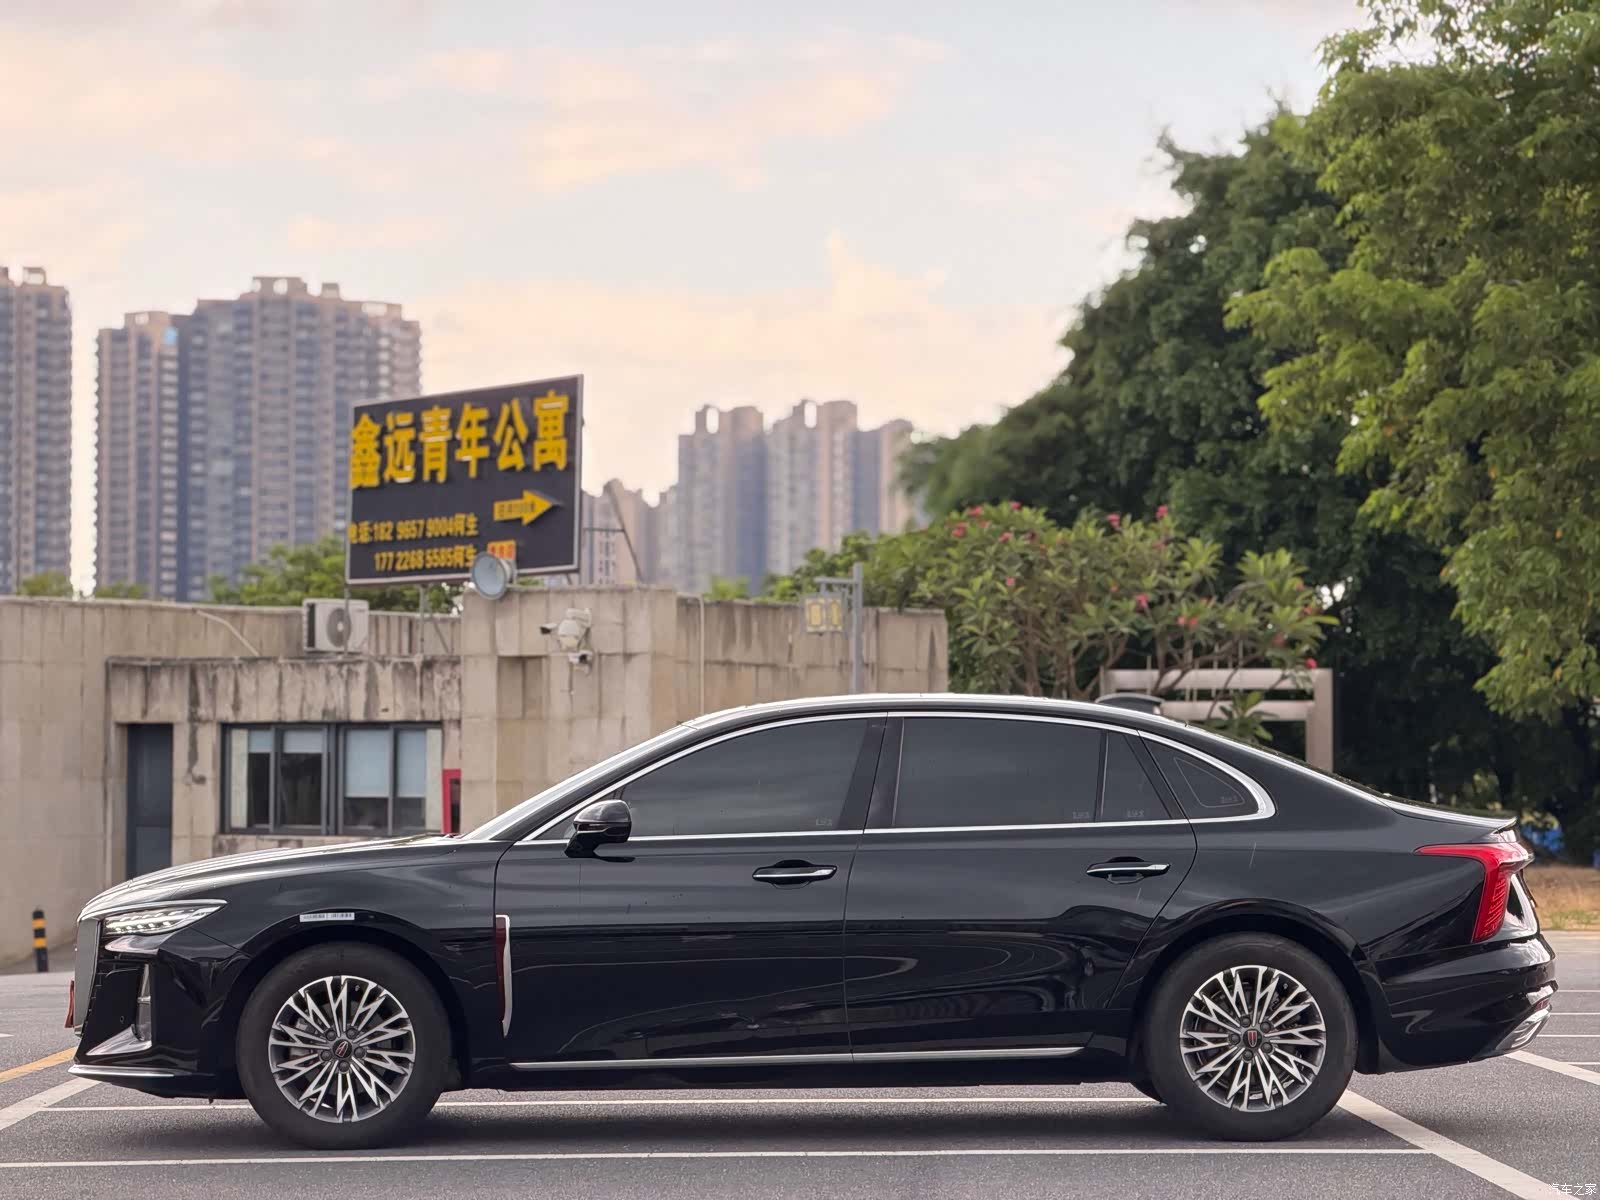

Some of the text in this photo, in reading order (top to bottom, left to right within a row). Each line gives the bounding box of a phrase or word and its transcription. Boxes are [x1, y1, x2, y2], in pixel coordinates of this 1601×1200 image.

[349, 389, 569, 489] 鑫远青年公寓
